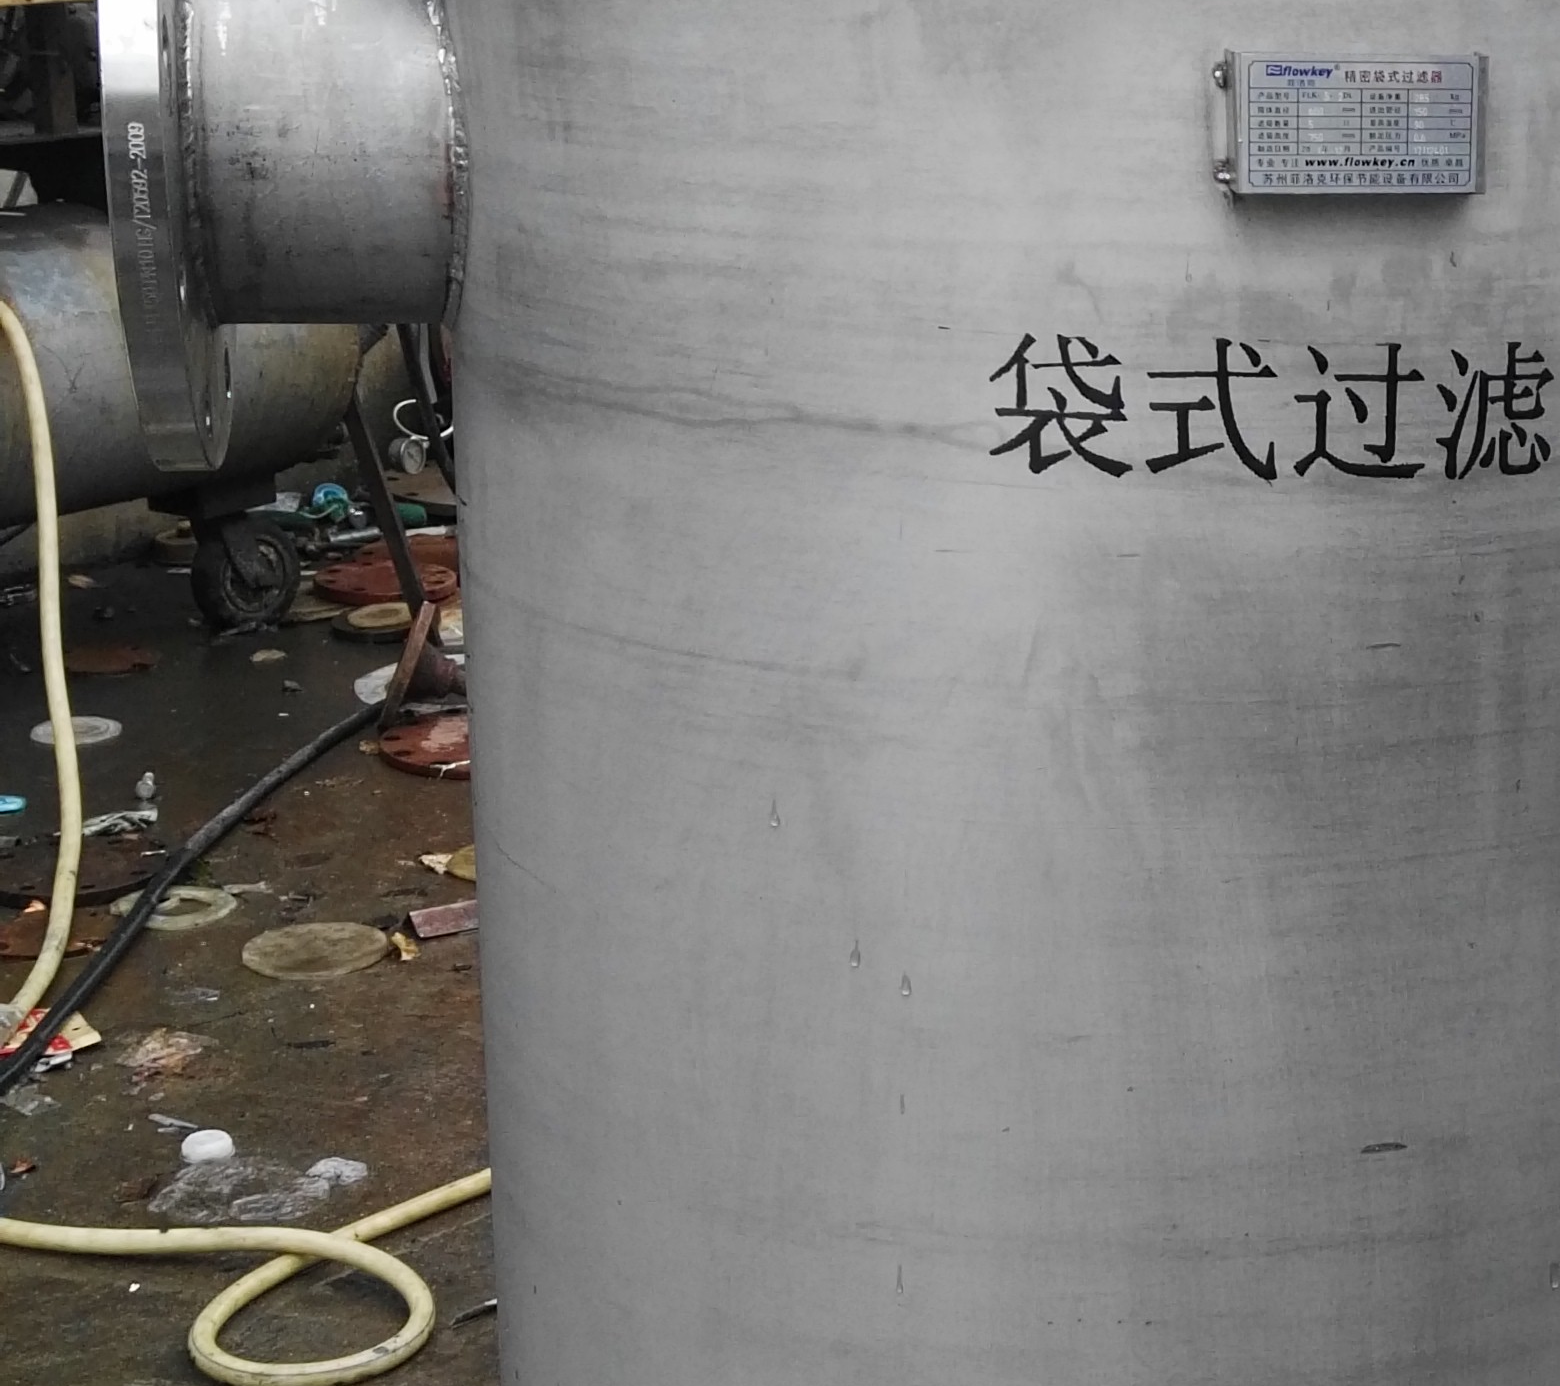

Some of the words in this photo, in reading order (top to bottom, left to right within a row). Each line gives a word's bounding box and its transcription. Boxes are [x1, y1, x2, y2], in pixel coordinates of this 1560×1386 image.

[1344, 69, 1442, 84] 精密袋式过滤器
[1304, 157, 1416, 168] www.flowkey.cn
